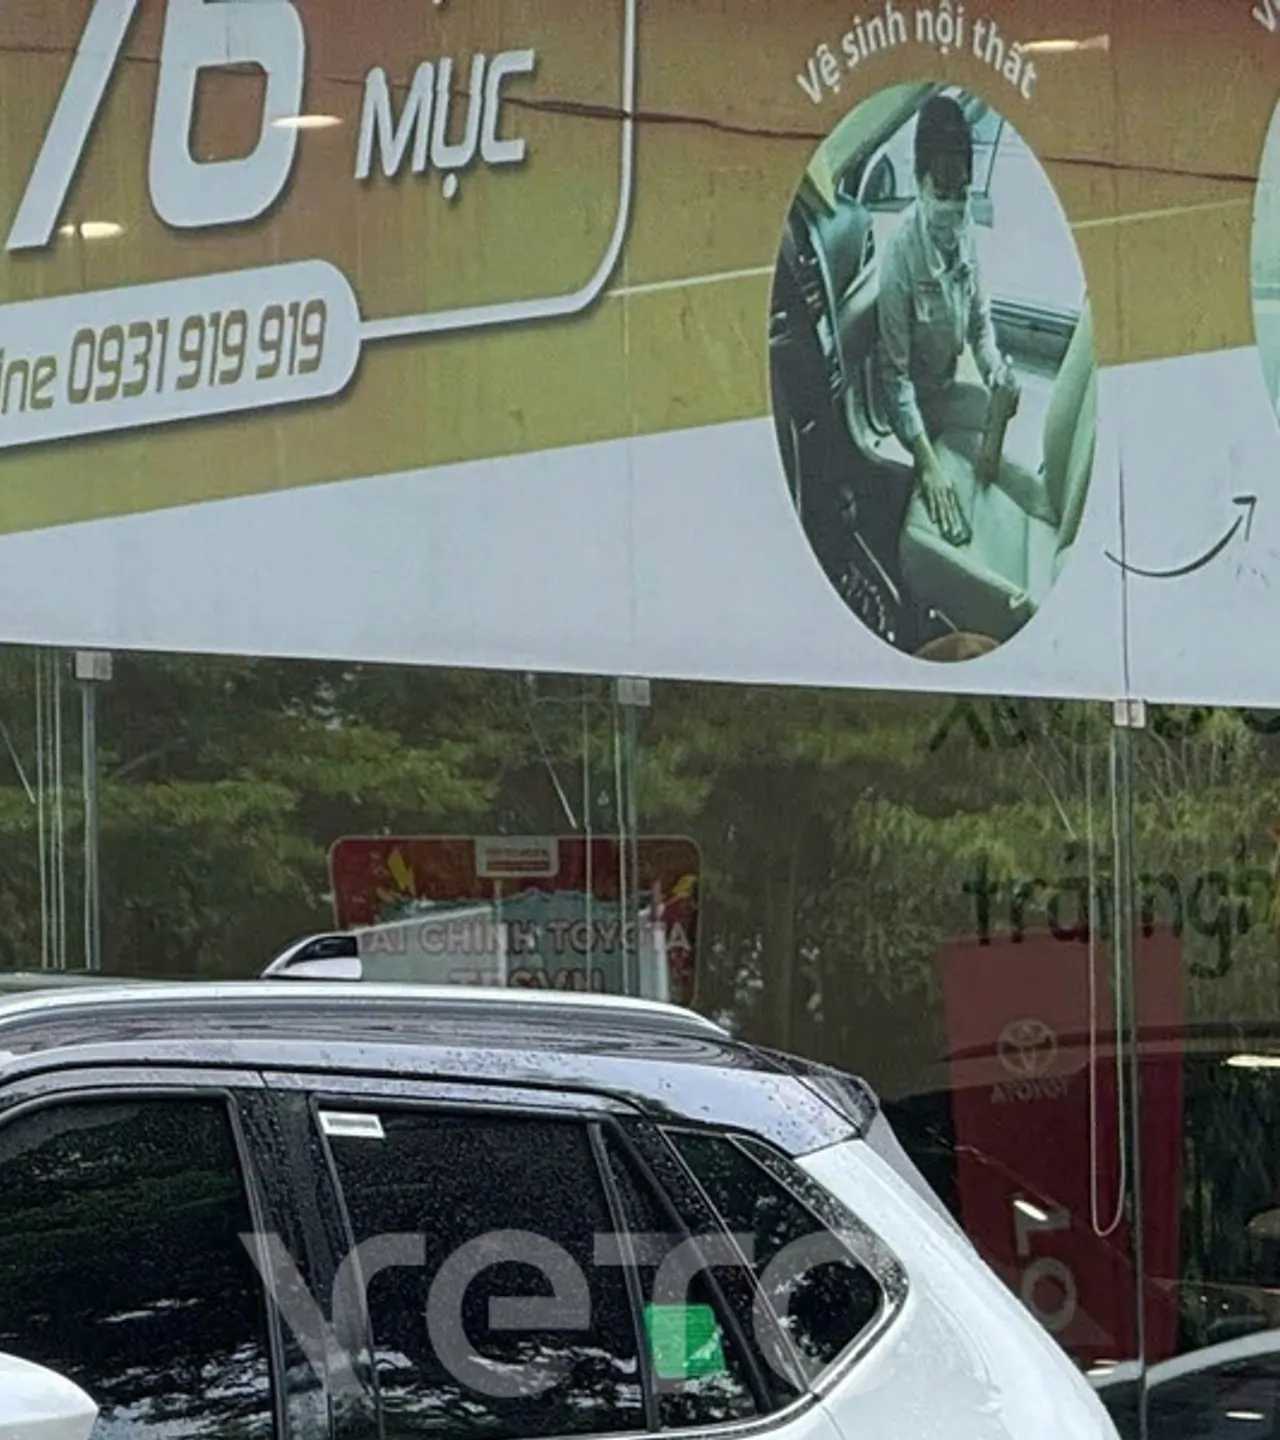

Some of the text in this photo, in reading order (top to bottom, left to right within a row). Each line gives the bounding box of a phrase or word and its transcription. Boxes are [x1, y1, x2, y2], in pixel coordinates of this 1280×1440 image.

[796, 43, 842, 106] Vệ
[842, 4, 908, 68] sinh
[915, 3, 965, 55] nội
[354, 48, 536, 201] MỤC
[67, 318, 170, 402] 0931
[178, 308, 248, 387] 919
[256, 298, 328, 381] 919
